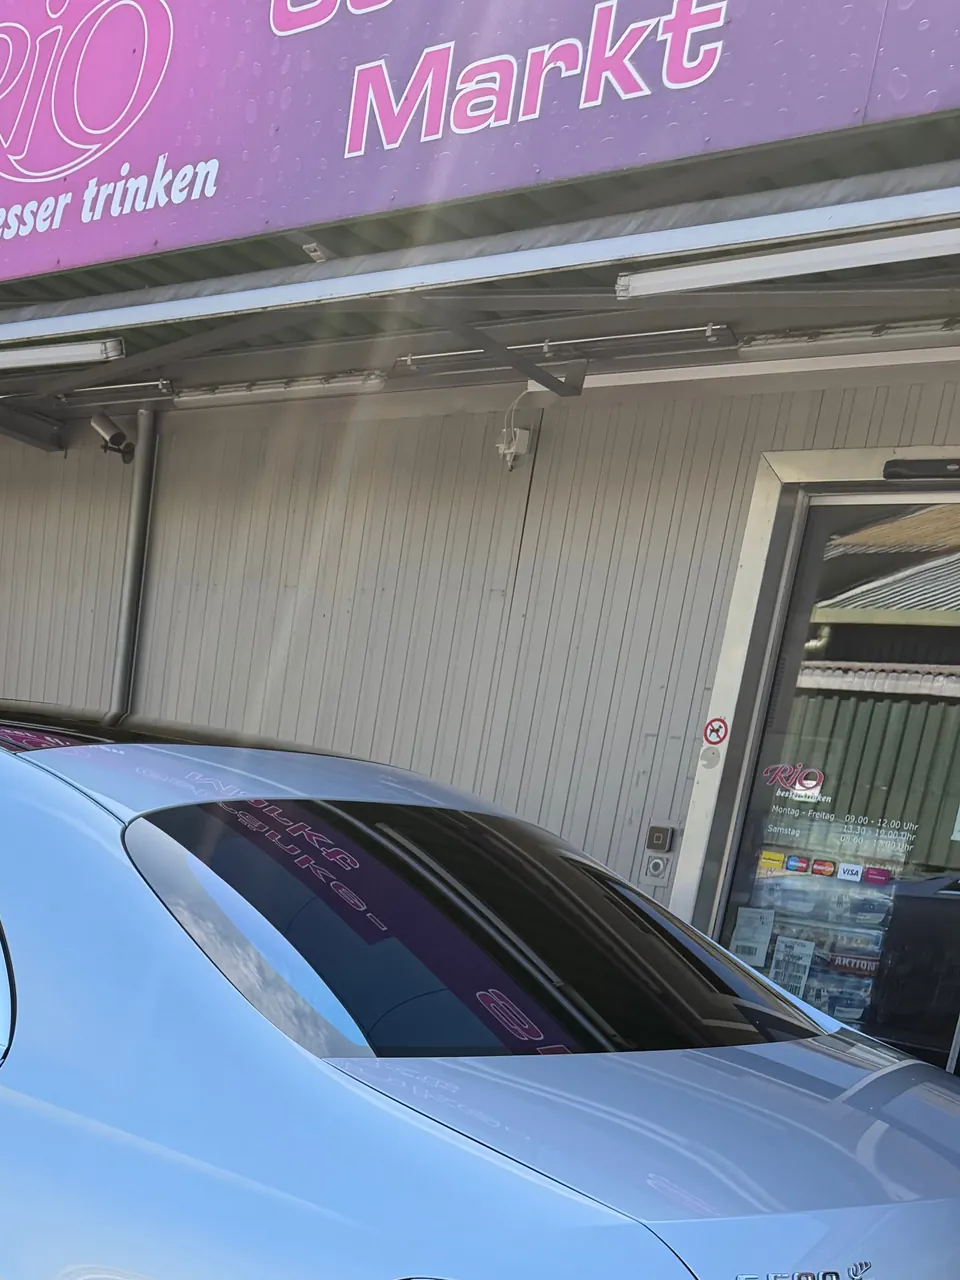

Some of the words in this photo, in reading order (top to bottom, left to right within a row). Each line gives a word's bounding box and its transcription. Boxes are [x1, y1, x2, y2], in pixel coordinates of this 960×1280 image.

[344, 0, 730, 158] Markt
[80, 152, 220, 224] trinken
[771, 805, 800, 817] Montag
[808, 809, 835, 822] Freitag
[845, 814, 868, 825] 09.00
[877, 818, 901, 829] 12.00
[903, 821, 919, 832] Uhr
[767, 824, 801, 838] Samstag
[898, 842, 914, 852] Uhr
[901, 832, 917, 841] Uhr
[842, 867, 859, 877] VISA
[835, 956, 876, 970] AKTION
